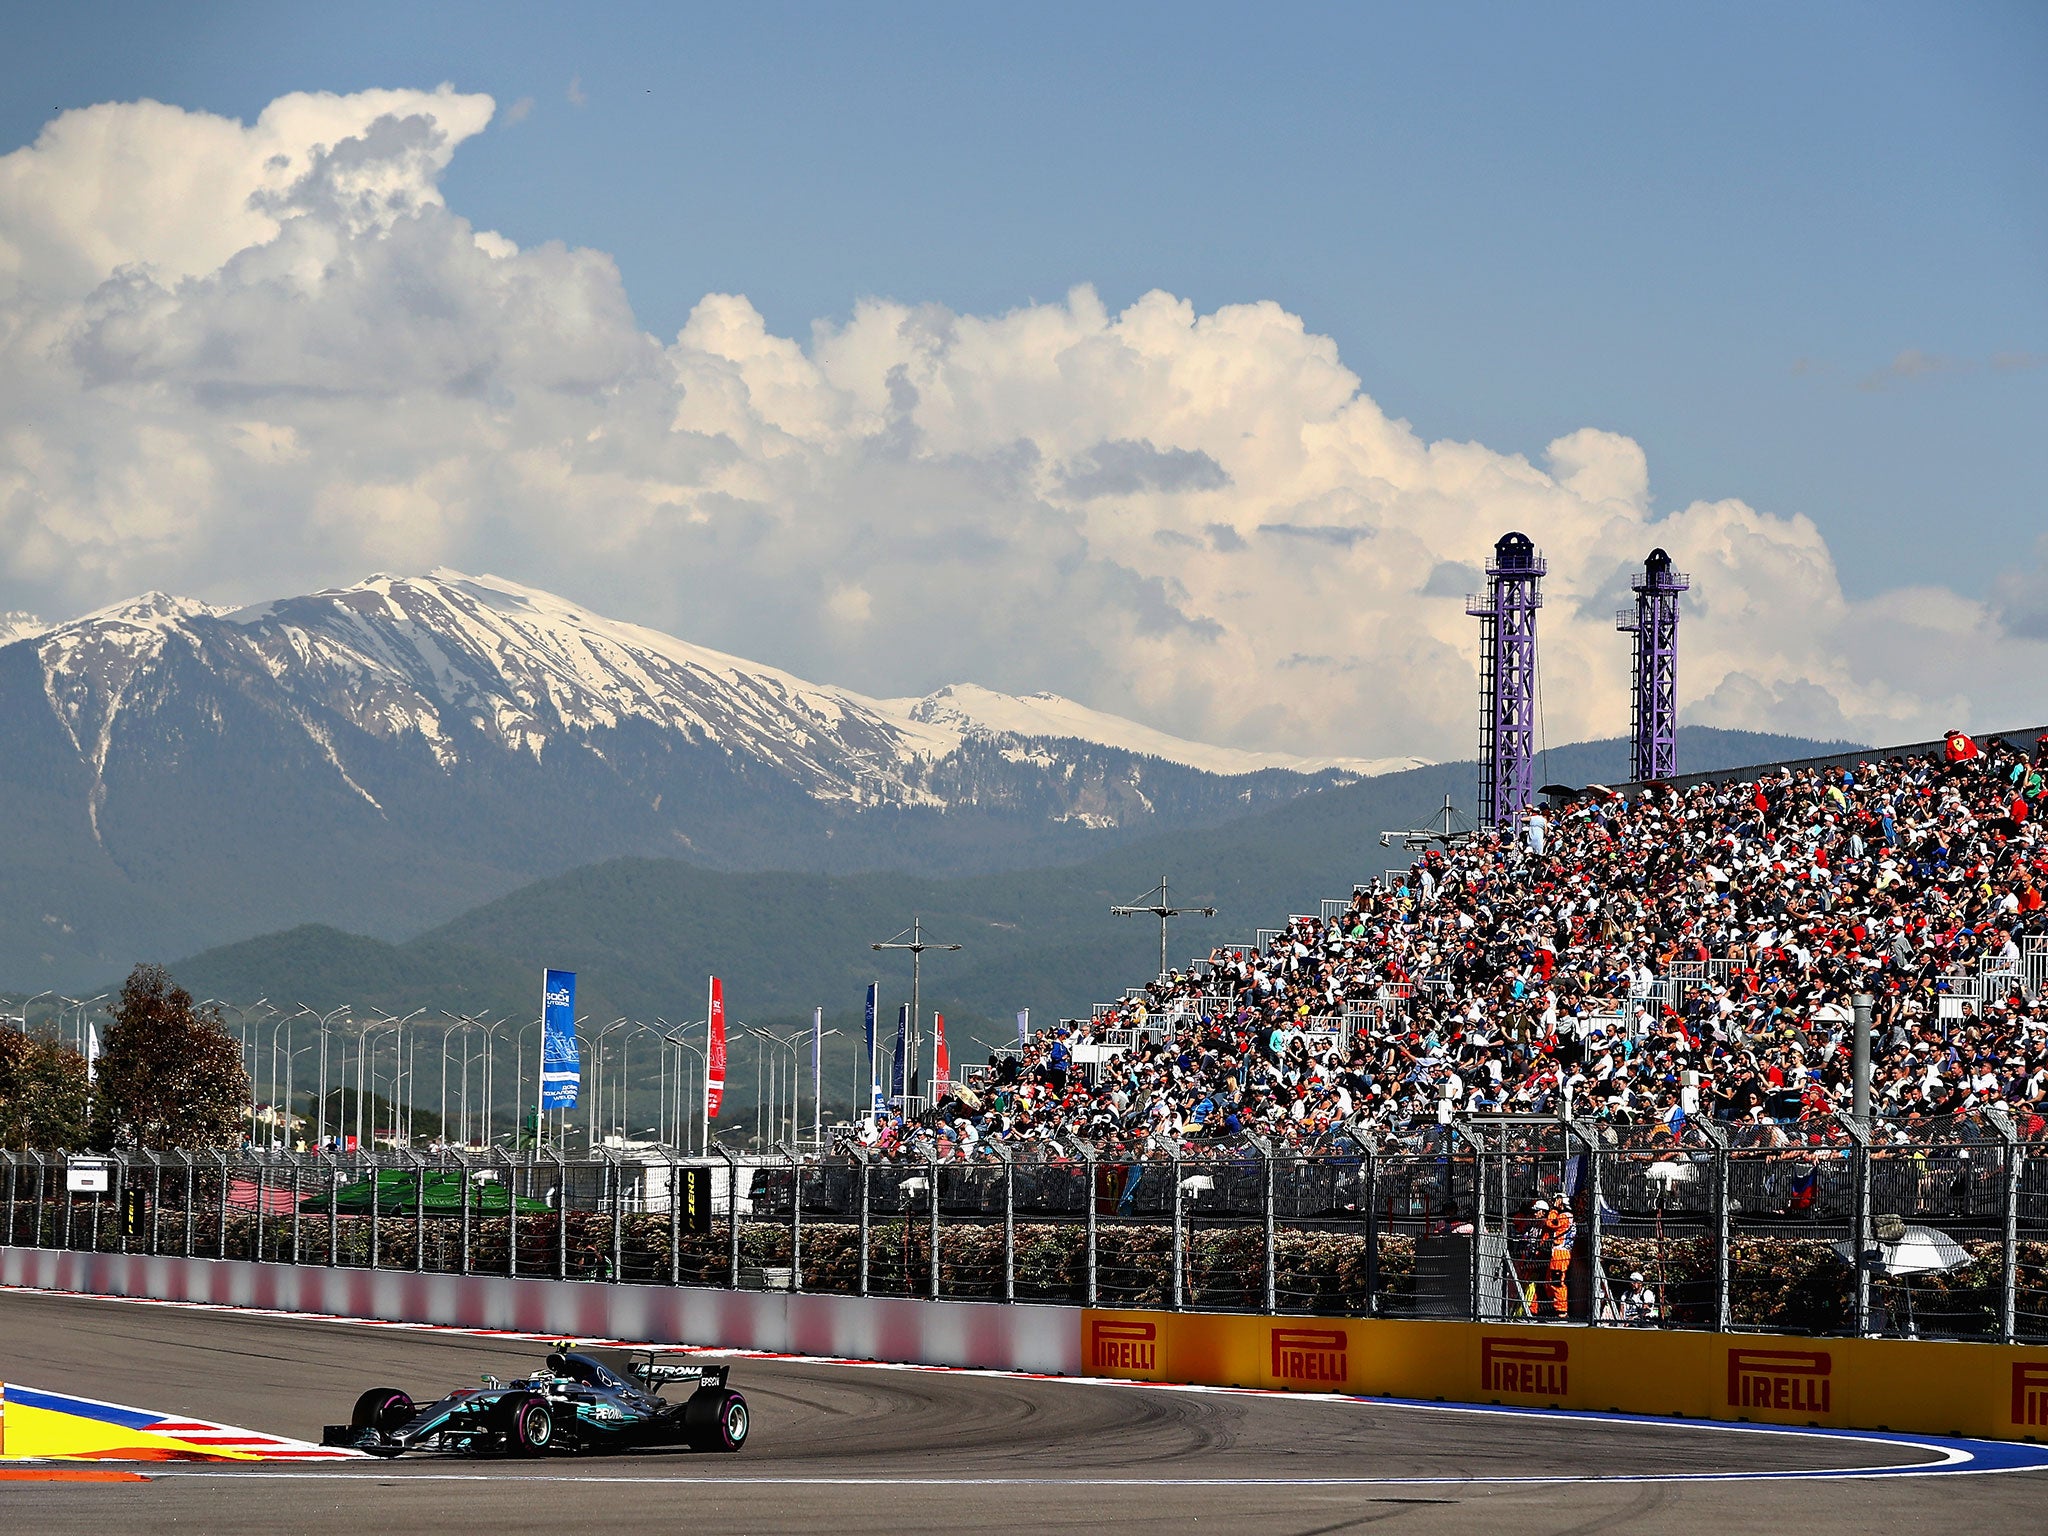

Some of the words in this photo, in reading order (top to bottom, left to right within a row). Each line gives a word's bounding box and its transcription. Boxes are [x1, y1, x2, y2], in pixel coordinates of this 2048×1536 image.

[547, 992, 570, 1002] SOCHI
[1092, 1320, 1156, 1370] PIRELLI
[1271, 1328, 1348, 1381] PIRELLI
[1482, 1337, 1568, 1395] PIRELLI
[701, 1377, 720, 1387] EPSON
[1728, 1348, 1832, 1413] PIRELLI
